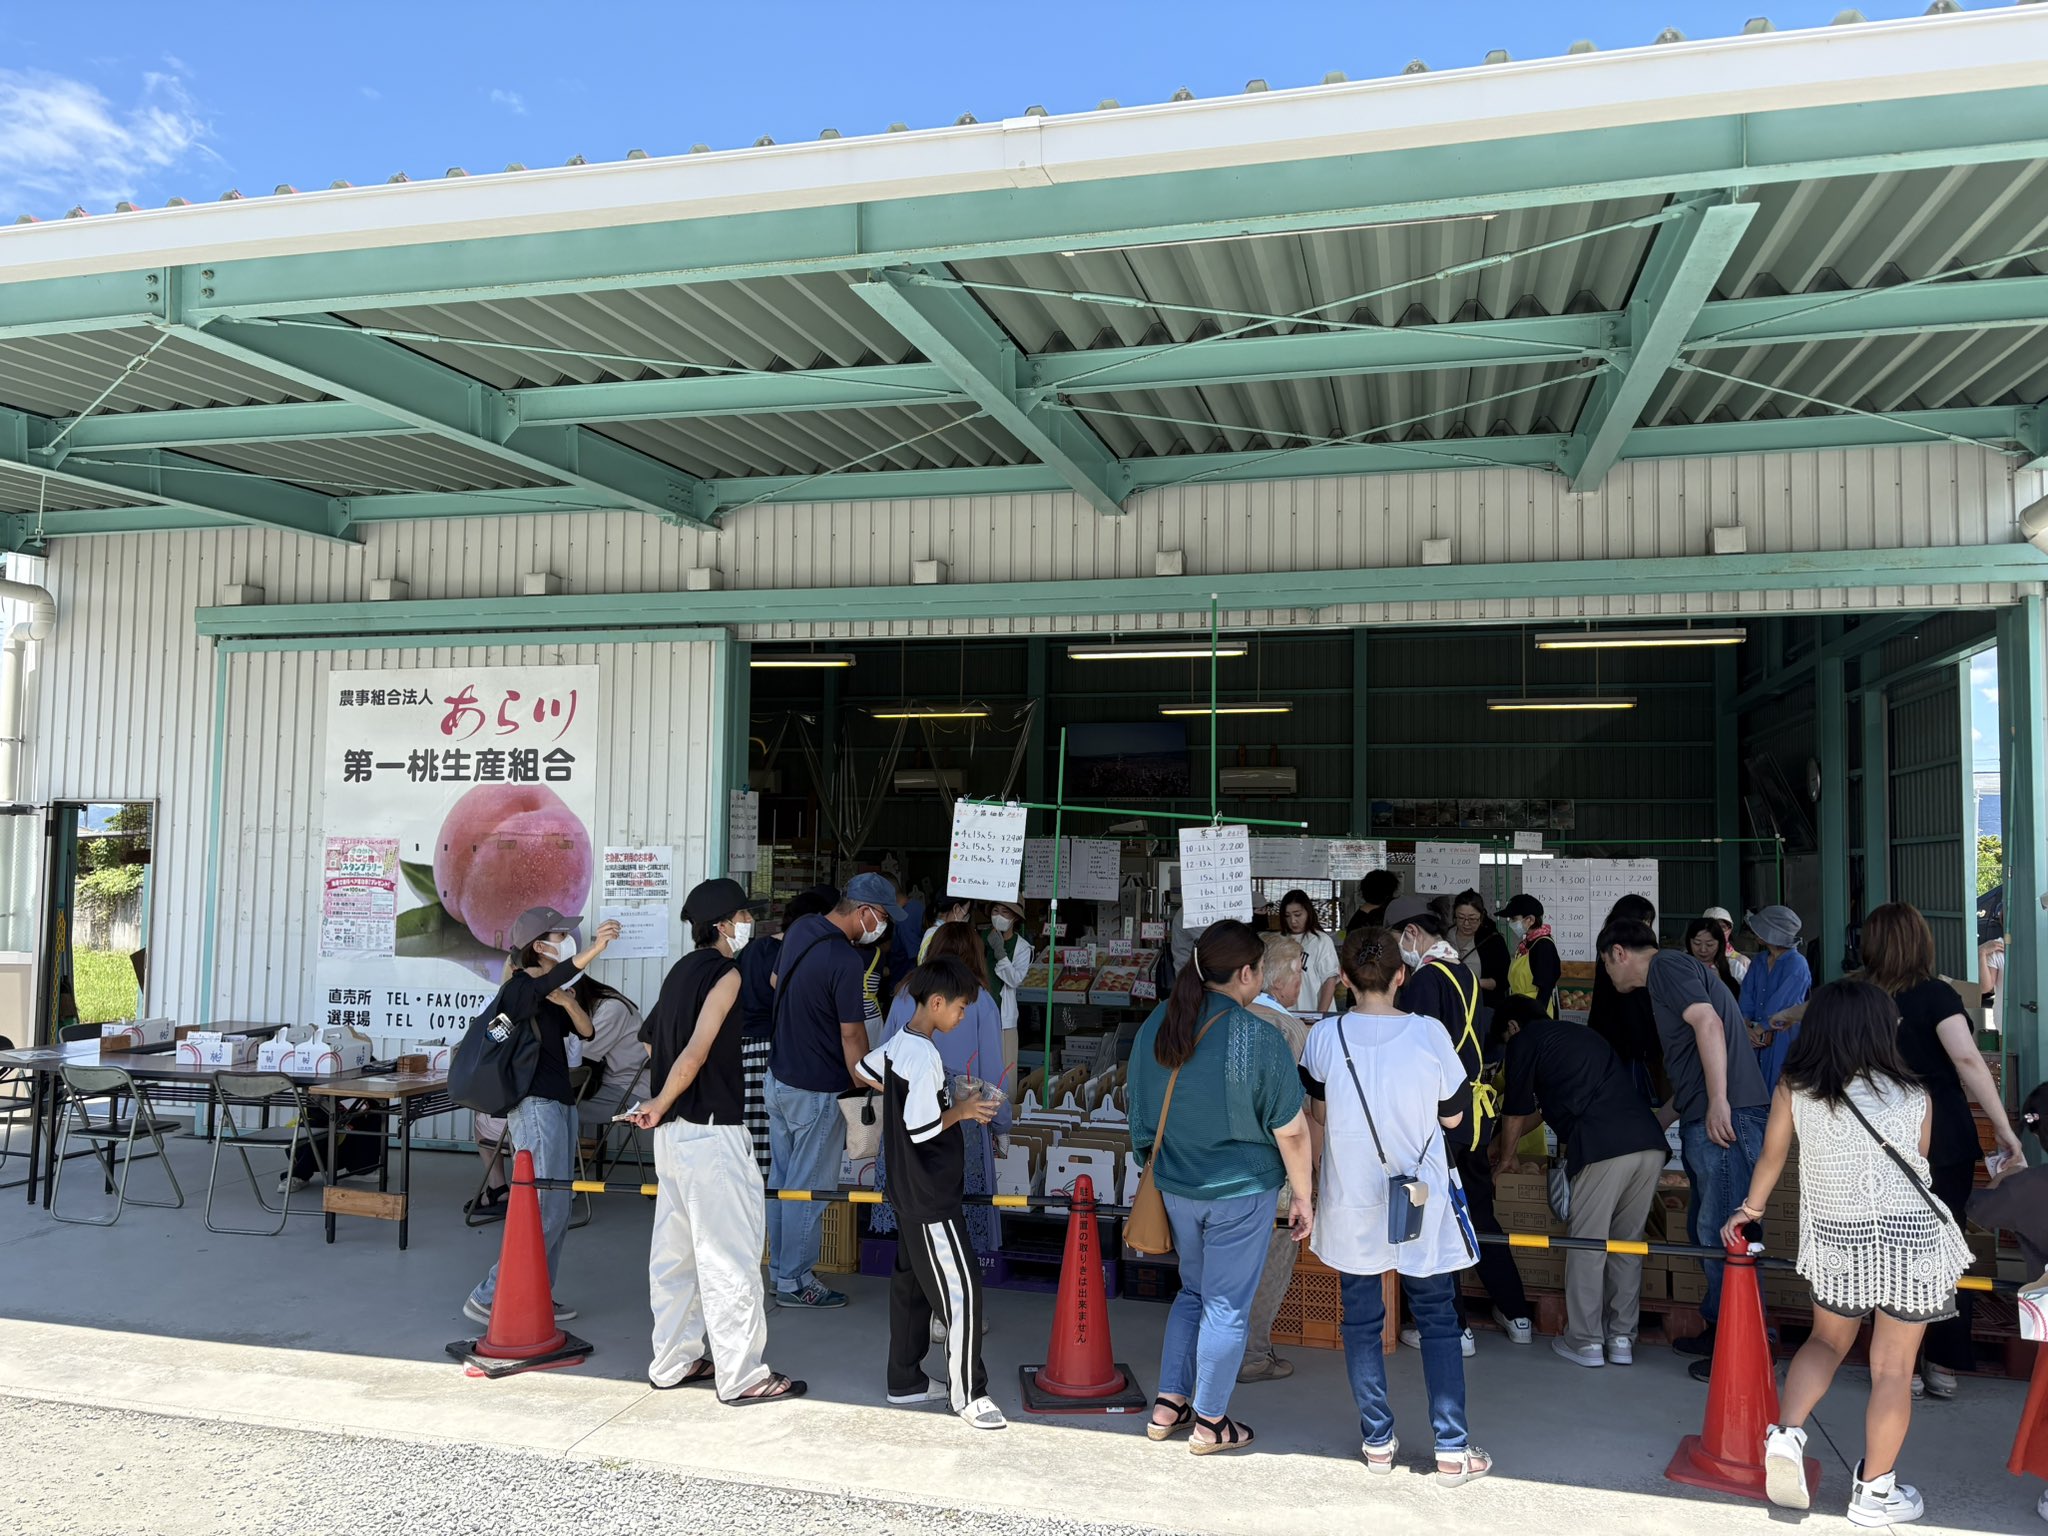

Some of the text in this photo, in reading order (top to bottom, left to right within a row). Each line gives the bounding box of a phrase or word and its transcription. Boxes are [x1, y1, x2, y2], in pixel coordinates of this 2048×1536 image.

[339, 683, 577, 742] 農事組合法人 あら川
[343, 747, 576, 783] 第一桃生産組合
[328, 988, 372, 1006] 直売所
[327, 1009, 371, 1028] 選果場
[386, 1013, 413, 1027] TEL
